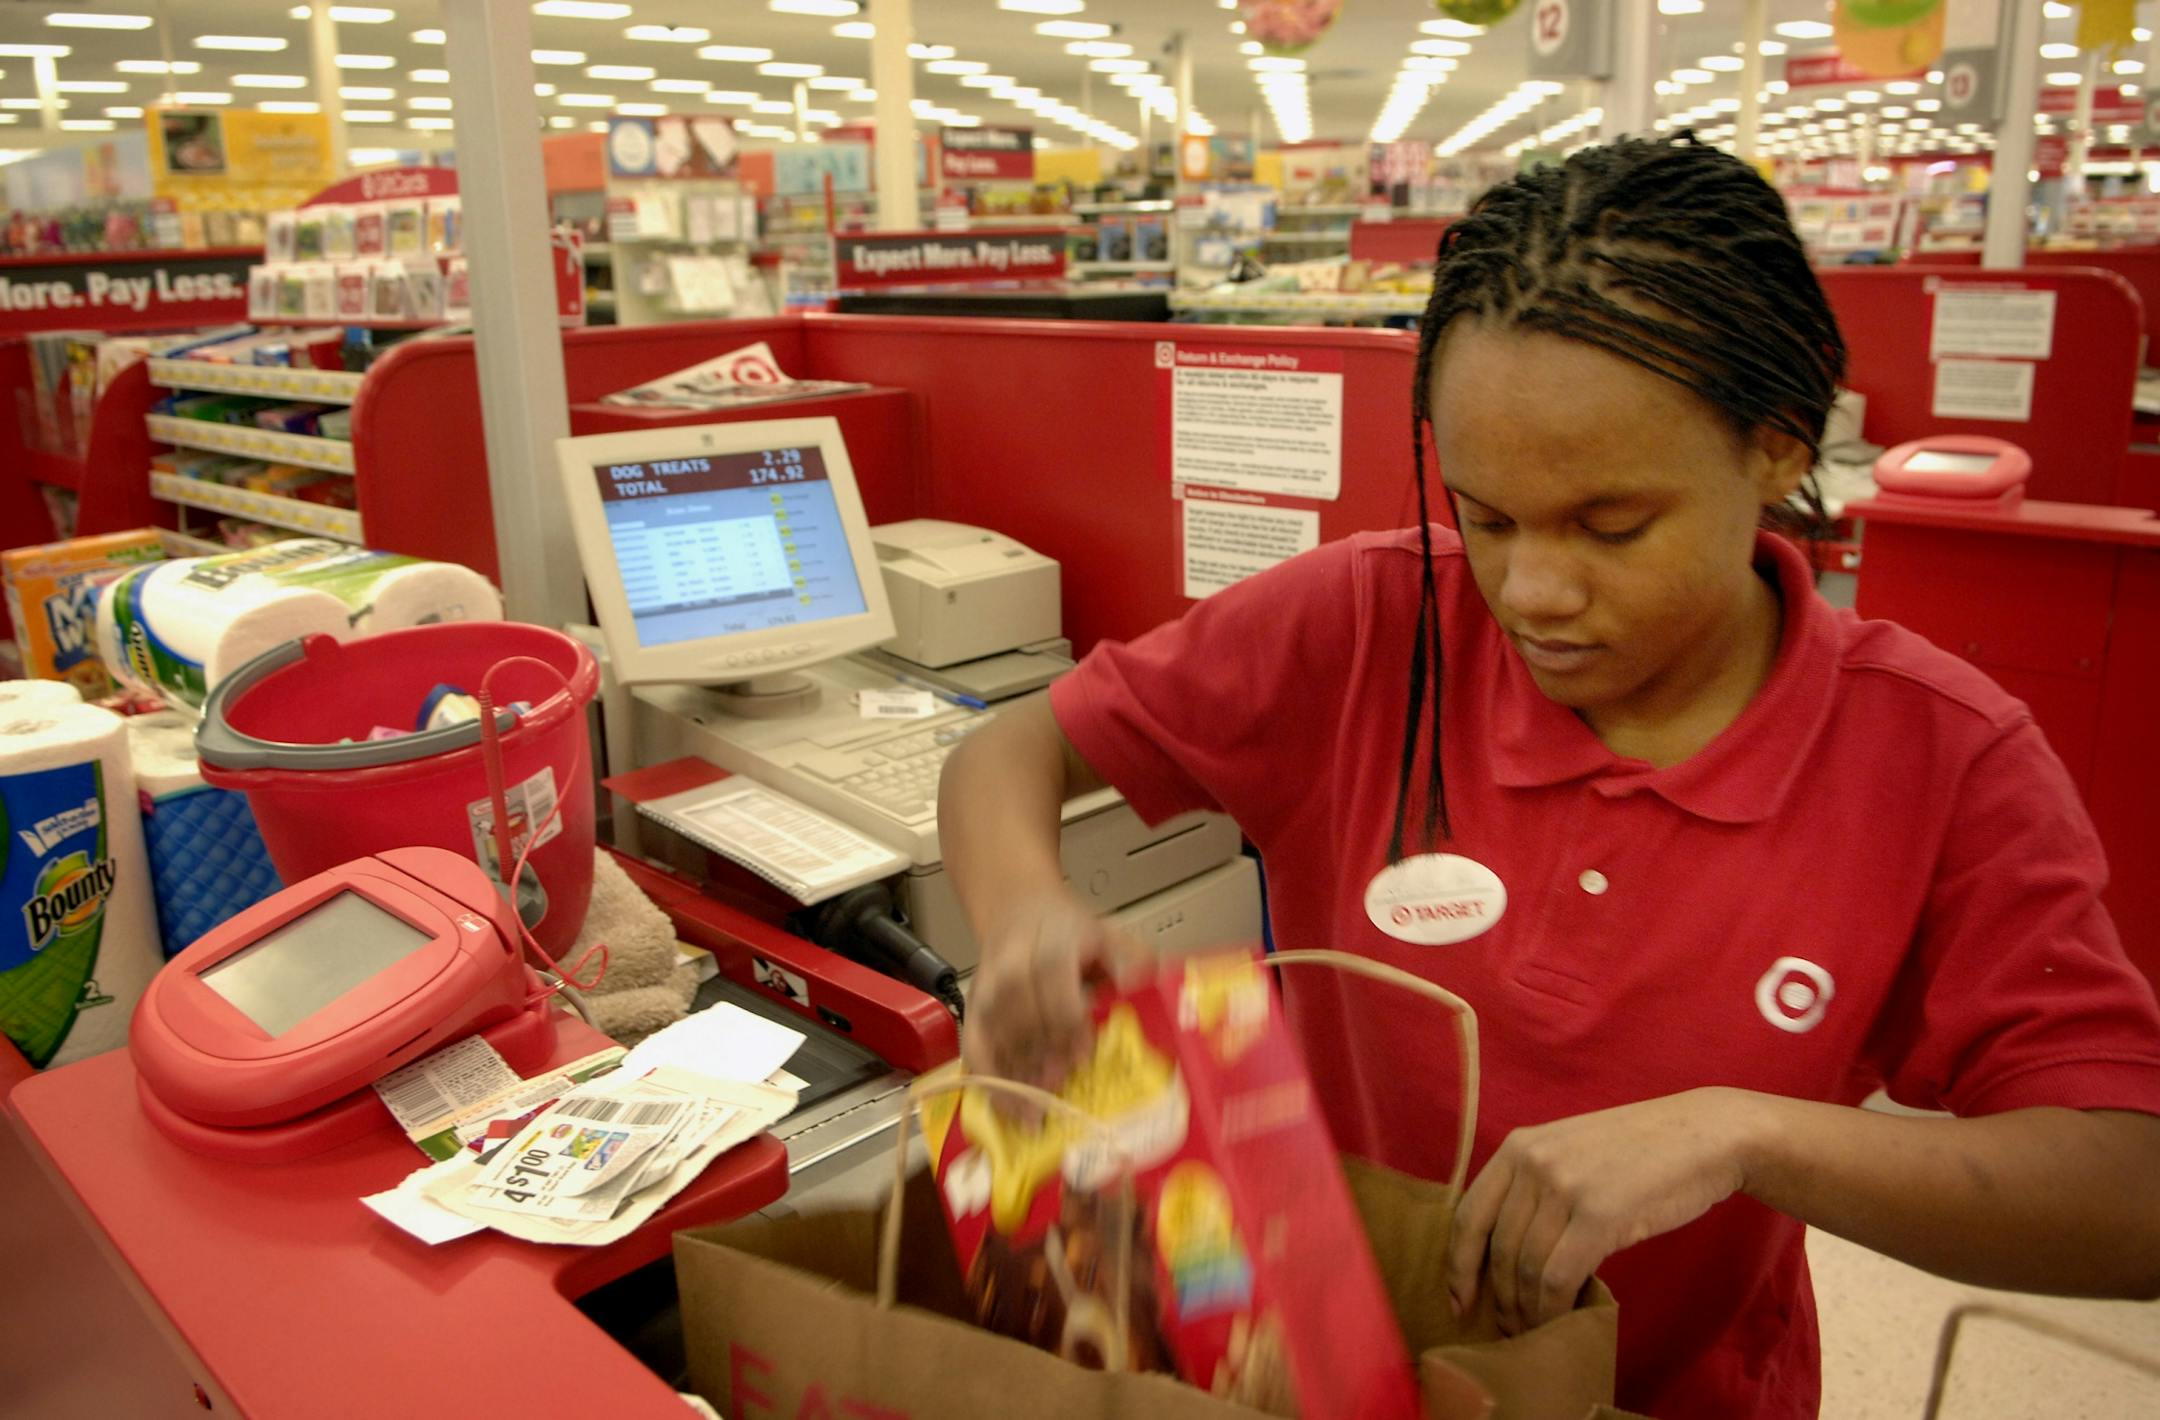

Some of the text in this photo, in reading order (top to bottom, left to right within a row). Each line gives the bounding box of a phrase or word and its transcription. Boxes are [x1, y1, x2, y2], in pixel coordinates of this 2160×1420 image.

[853, 240, 1056, 277] Expect More. Pay Less.
[0, 268, 243, 312] ore. Pay Less.
[1177, 351, 1208, 364] Return
[1219, 351, 1266, 367] Exchange
[1267, 353, 1299, 370] Policy
[609, 448, 801, 480] DOG TREATS 2.29
[614, 465, 805, 496] TOTAL 174.92
[25, 857, 116, 949] Bounty
[1415, 900, 1486, 922] TARGET
